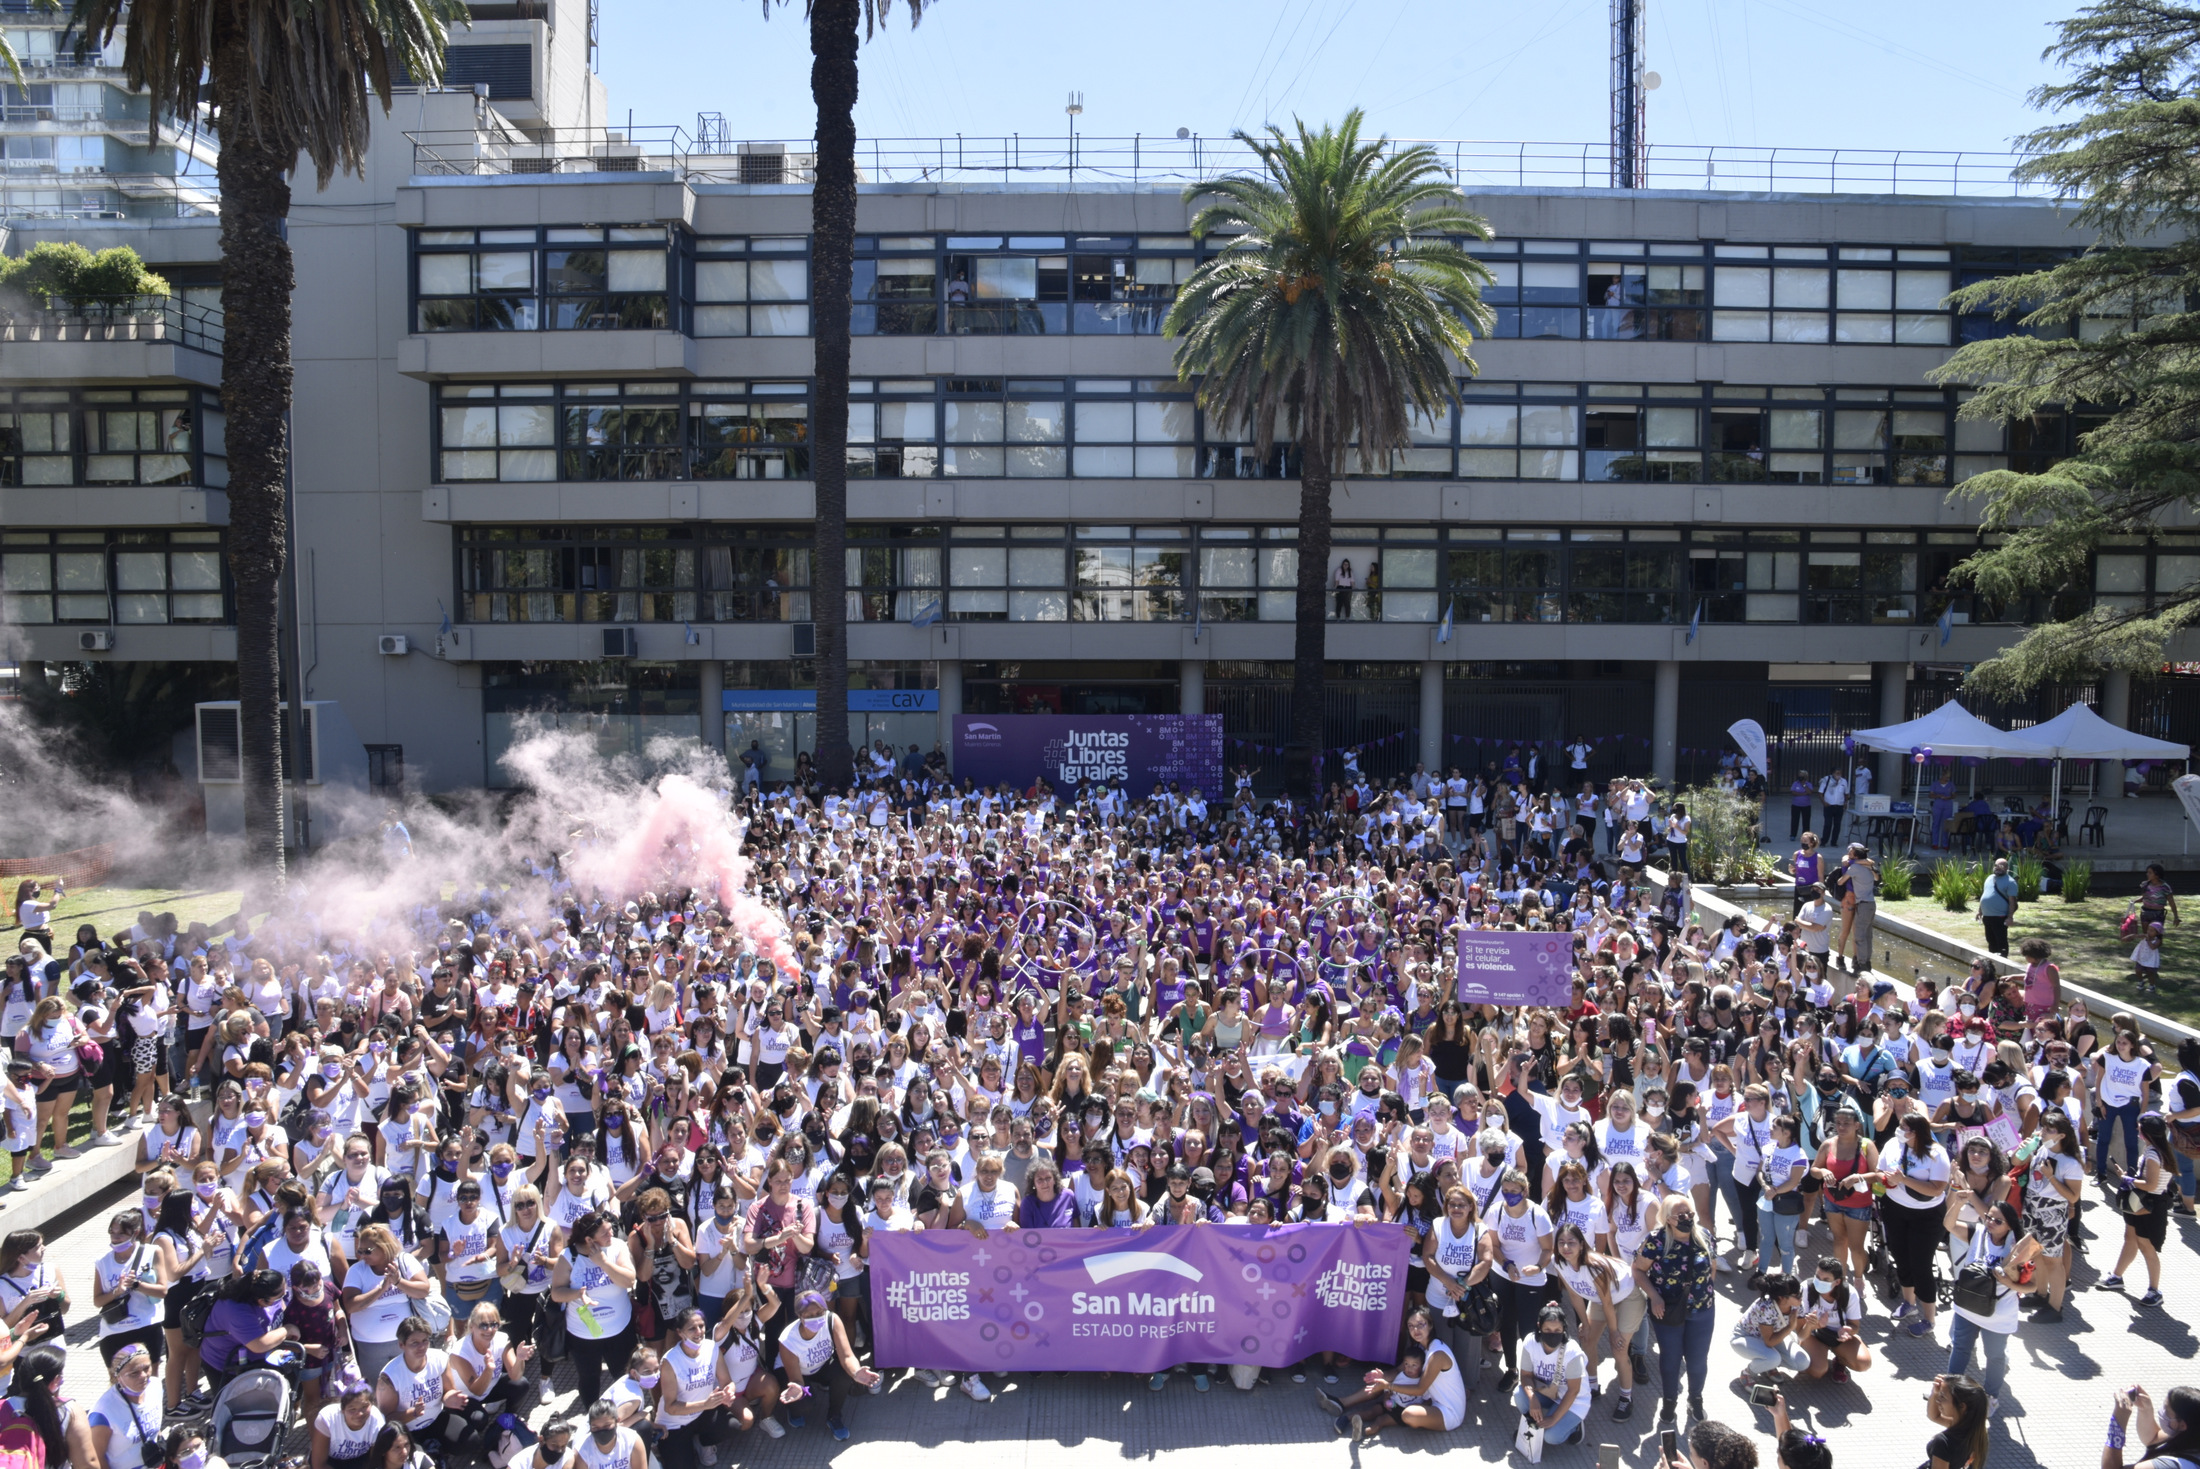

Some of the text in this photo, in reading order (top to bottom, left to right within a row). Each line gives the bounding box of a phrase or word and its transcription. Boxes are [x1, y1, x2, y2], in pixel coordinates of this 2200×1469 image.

[892, 693, 925, 708] cav
[1064, 730, 1129, 747] Juntas
[1059, 762, 1128, 784] Iguales
[1465, 945, 1510, 955] Si te revisa
[1476, 963, 1516, 971] violencia.
[2112, 1072, 2135, 1082] Libres
[2113, 1066, 2137, 1077] Juntas
[2109, 1076, 2136, 1087] Iguales
[1925, 1083, 1952, 1092] Iguales
[1505, 1228, 1524, 1238] Libres
[1506, 1222, 1525, 1233] Juntas
[1501, 1232, 1526, 1243] Iguales
[1446, 1242, 1473, 1253] Juntas
[1445, 1248, 1473, 1259] Libres
[1441, 1254, 1475, 1267] Iguales
[1331, 1258, 1393, 1282] Juntas
[904, 1270, 970, 1289] Juntas
[1072, 1290, 1216, 1317] San Martín
[1323, 1290, 1387, 1312] Iguales
[902, 1302, 970, 1324] Iguales
[1072, 1320, 1216, 1339] ESTADO PRESENTE
